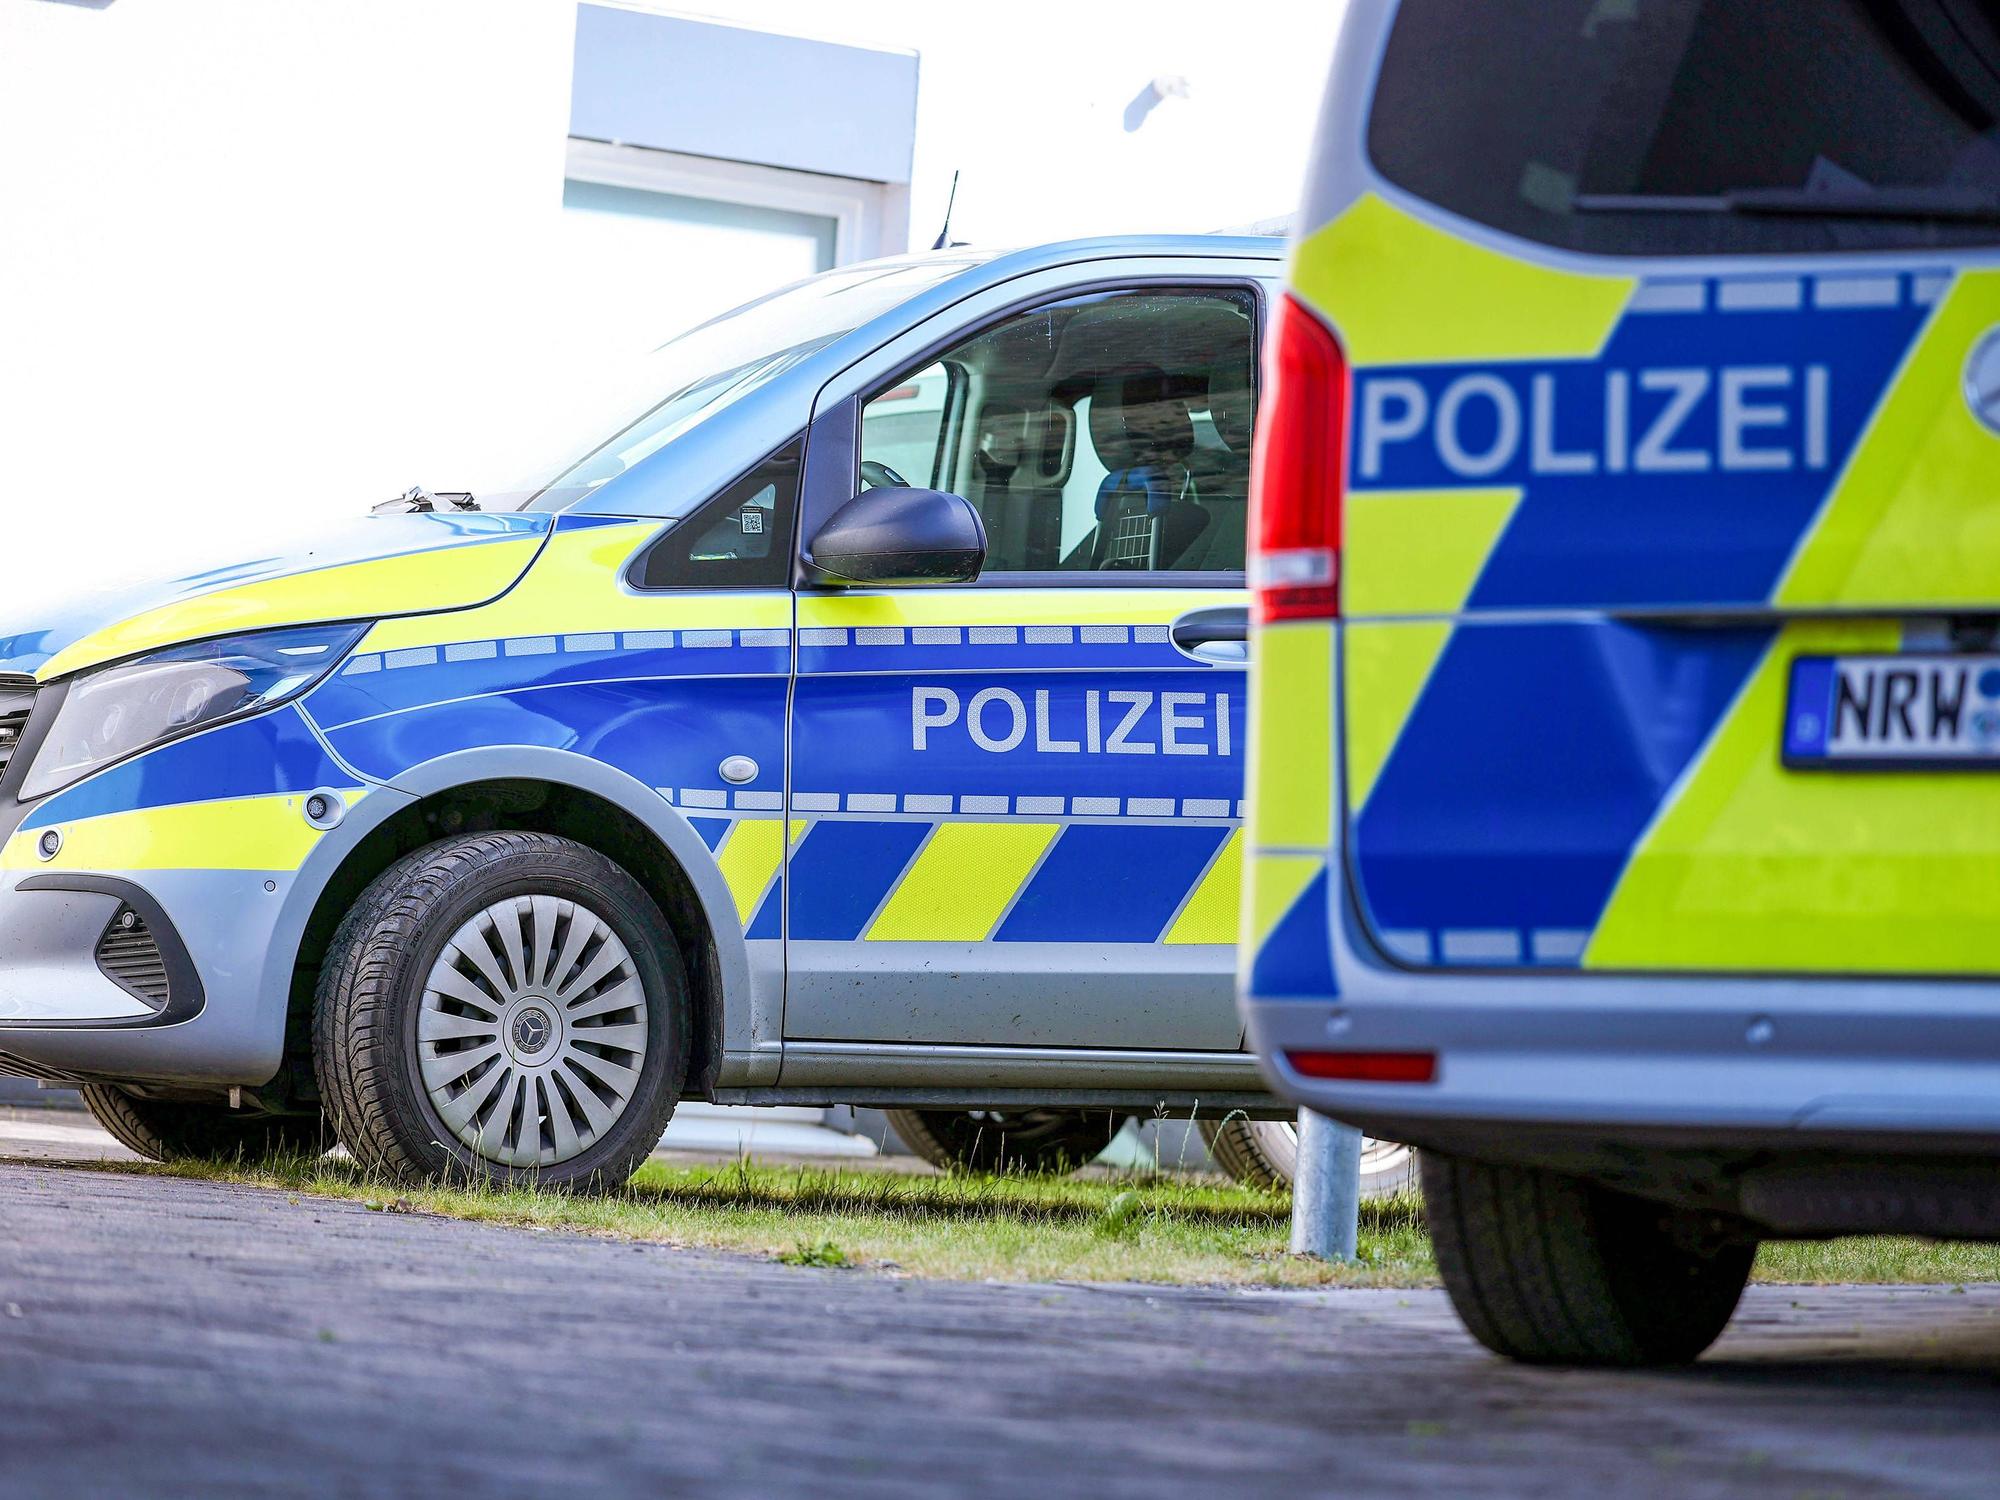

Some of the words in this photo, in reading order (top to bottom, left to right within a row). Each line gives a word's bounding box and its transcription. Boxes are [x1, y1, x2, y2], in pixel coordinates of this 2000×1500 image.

[1360, 366, 1828, 478] POLIZEI
[911, 686, 1230, 756] POLIZEI
[1834, 670, 1967, 740] NRW
[410, 930, 423, 948] 200
